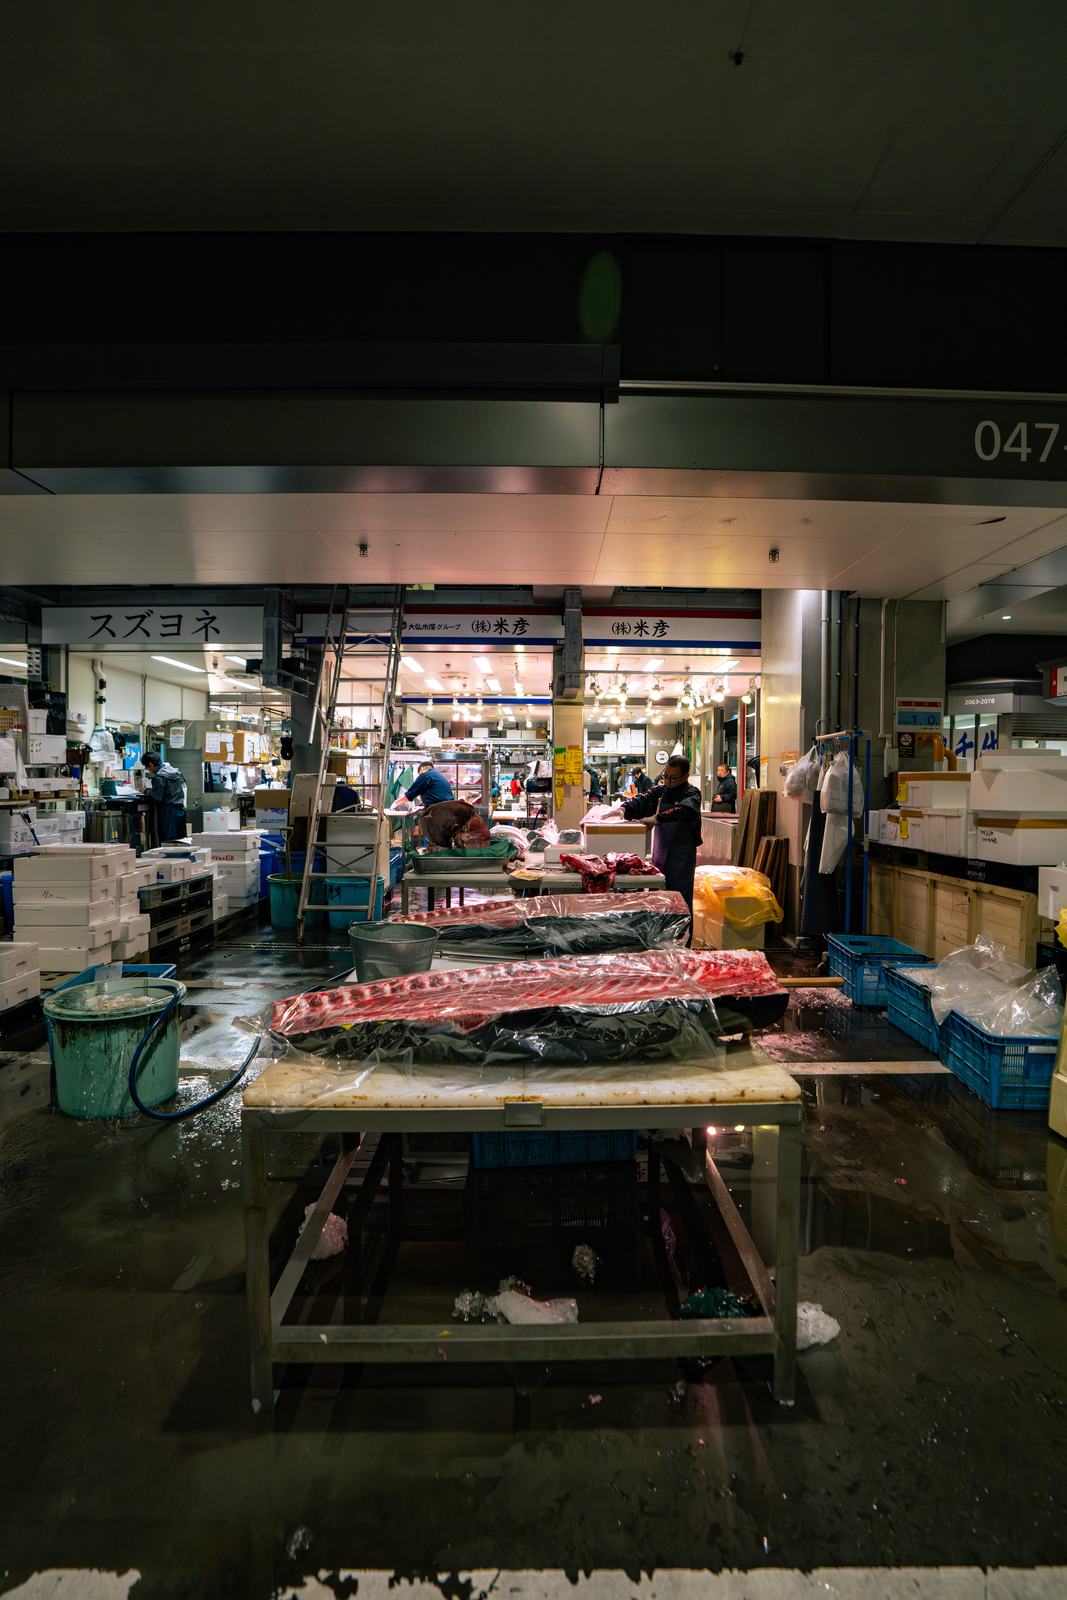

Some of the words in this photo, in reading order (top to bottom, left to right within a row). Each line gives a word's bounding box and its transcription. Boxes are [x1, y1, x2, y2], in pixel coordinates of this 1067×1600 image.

[974, 419, 1067, 463] 047
[87, 608, 221, 642] スズヨネ
